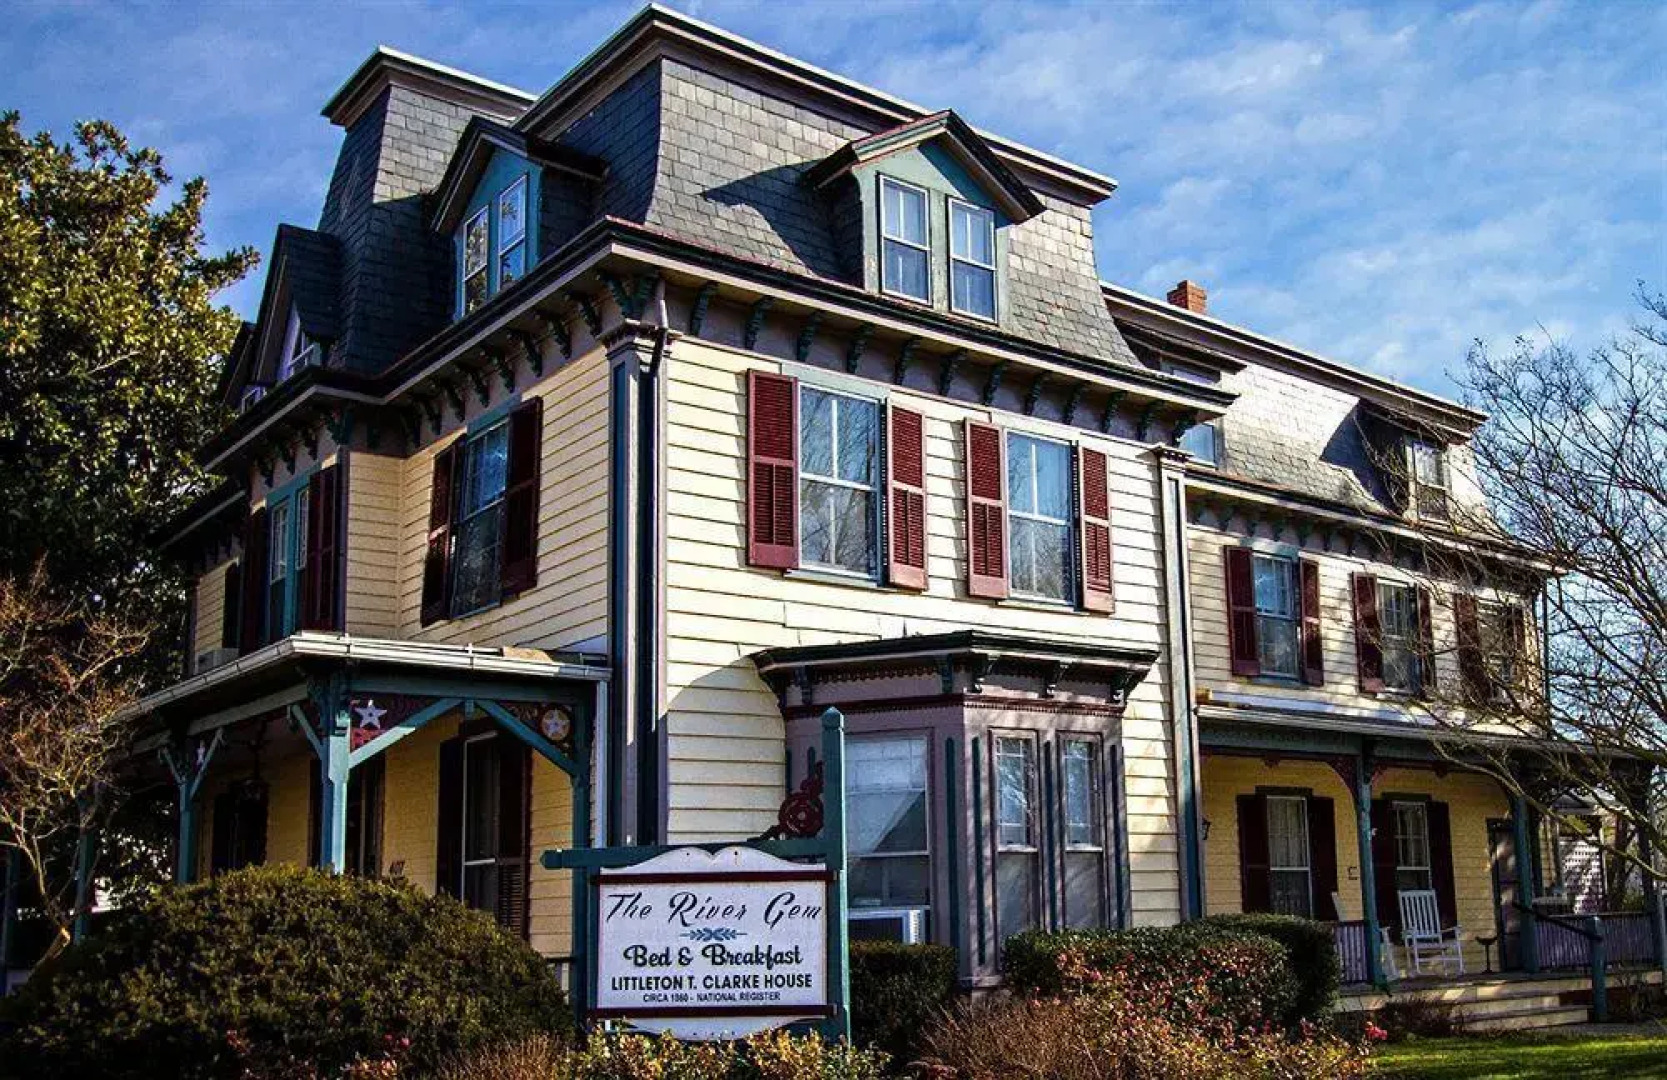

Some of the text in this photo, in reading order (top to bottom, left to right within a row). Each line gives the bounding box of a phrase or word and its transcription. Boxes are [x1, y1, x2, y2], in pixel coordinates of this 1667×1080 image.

[606, 891, 822, 930] The River Gem
[623, 943, 803, 970] Bed & Breakfast
[611, 973, 812, 991] LITTLETON T. CLARKE HOUSE
[643, 992, 669, 1003] CIRCA
[697, 992, 737, 1002] NATIONAL
[739, 991, 781, 1001] REGISTER
